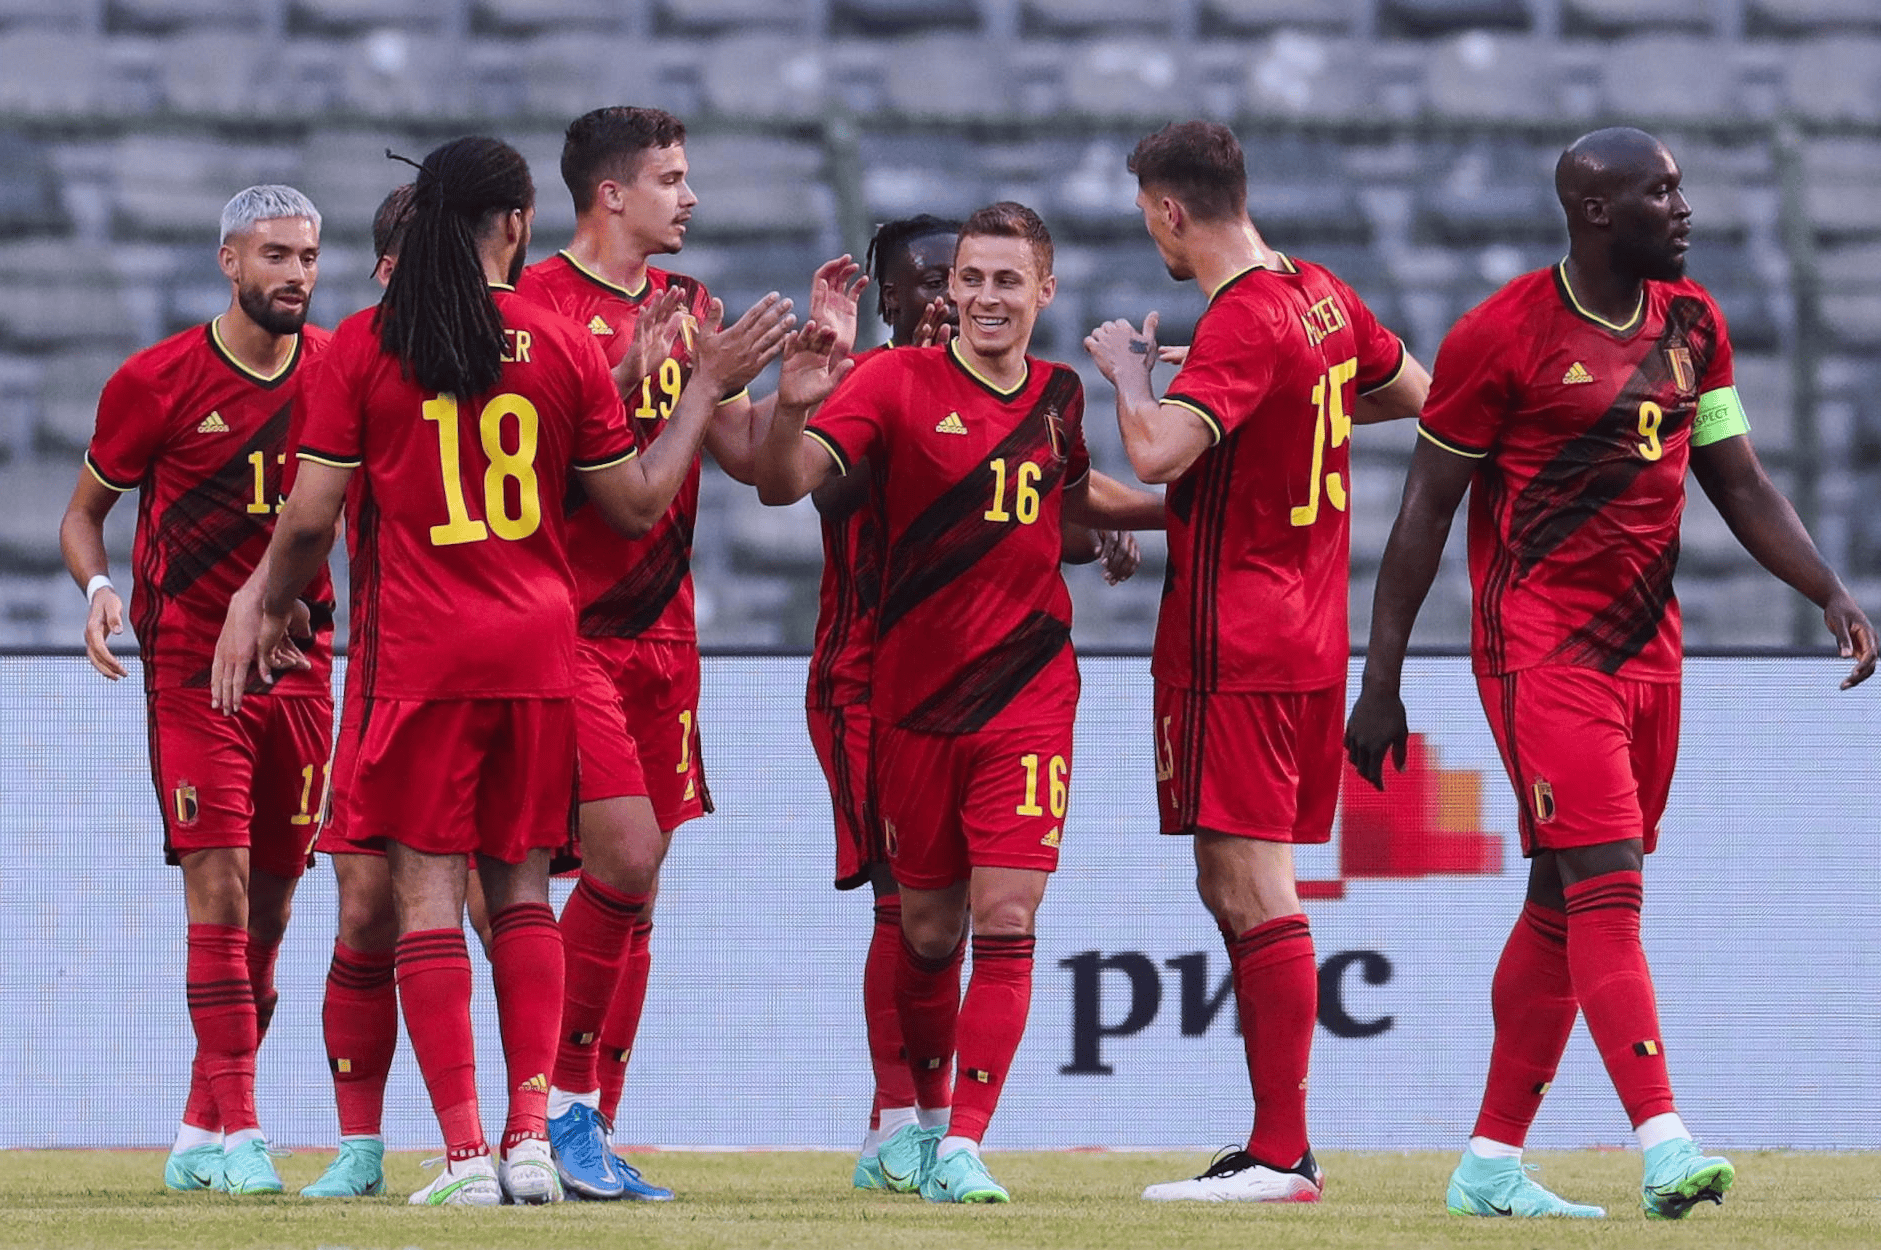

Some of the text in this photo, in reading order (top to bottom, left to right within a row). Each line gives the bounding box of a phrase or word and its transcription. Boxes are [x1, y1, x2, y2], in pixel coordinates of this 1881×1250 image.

[635, 357, 681, 420] 19
[1290, 357, 1358, 527] 15
[1638, 401, 1662, 461] 9
[422, 392, 541, 546] 18
[984, 458, 1042, 525] 16
[676, 709, 693, 774] 1
[1016, 754, 1067, 819] 16
